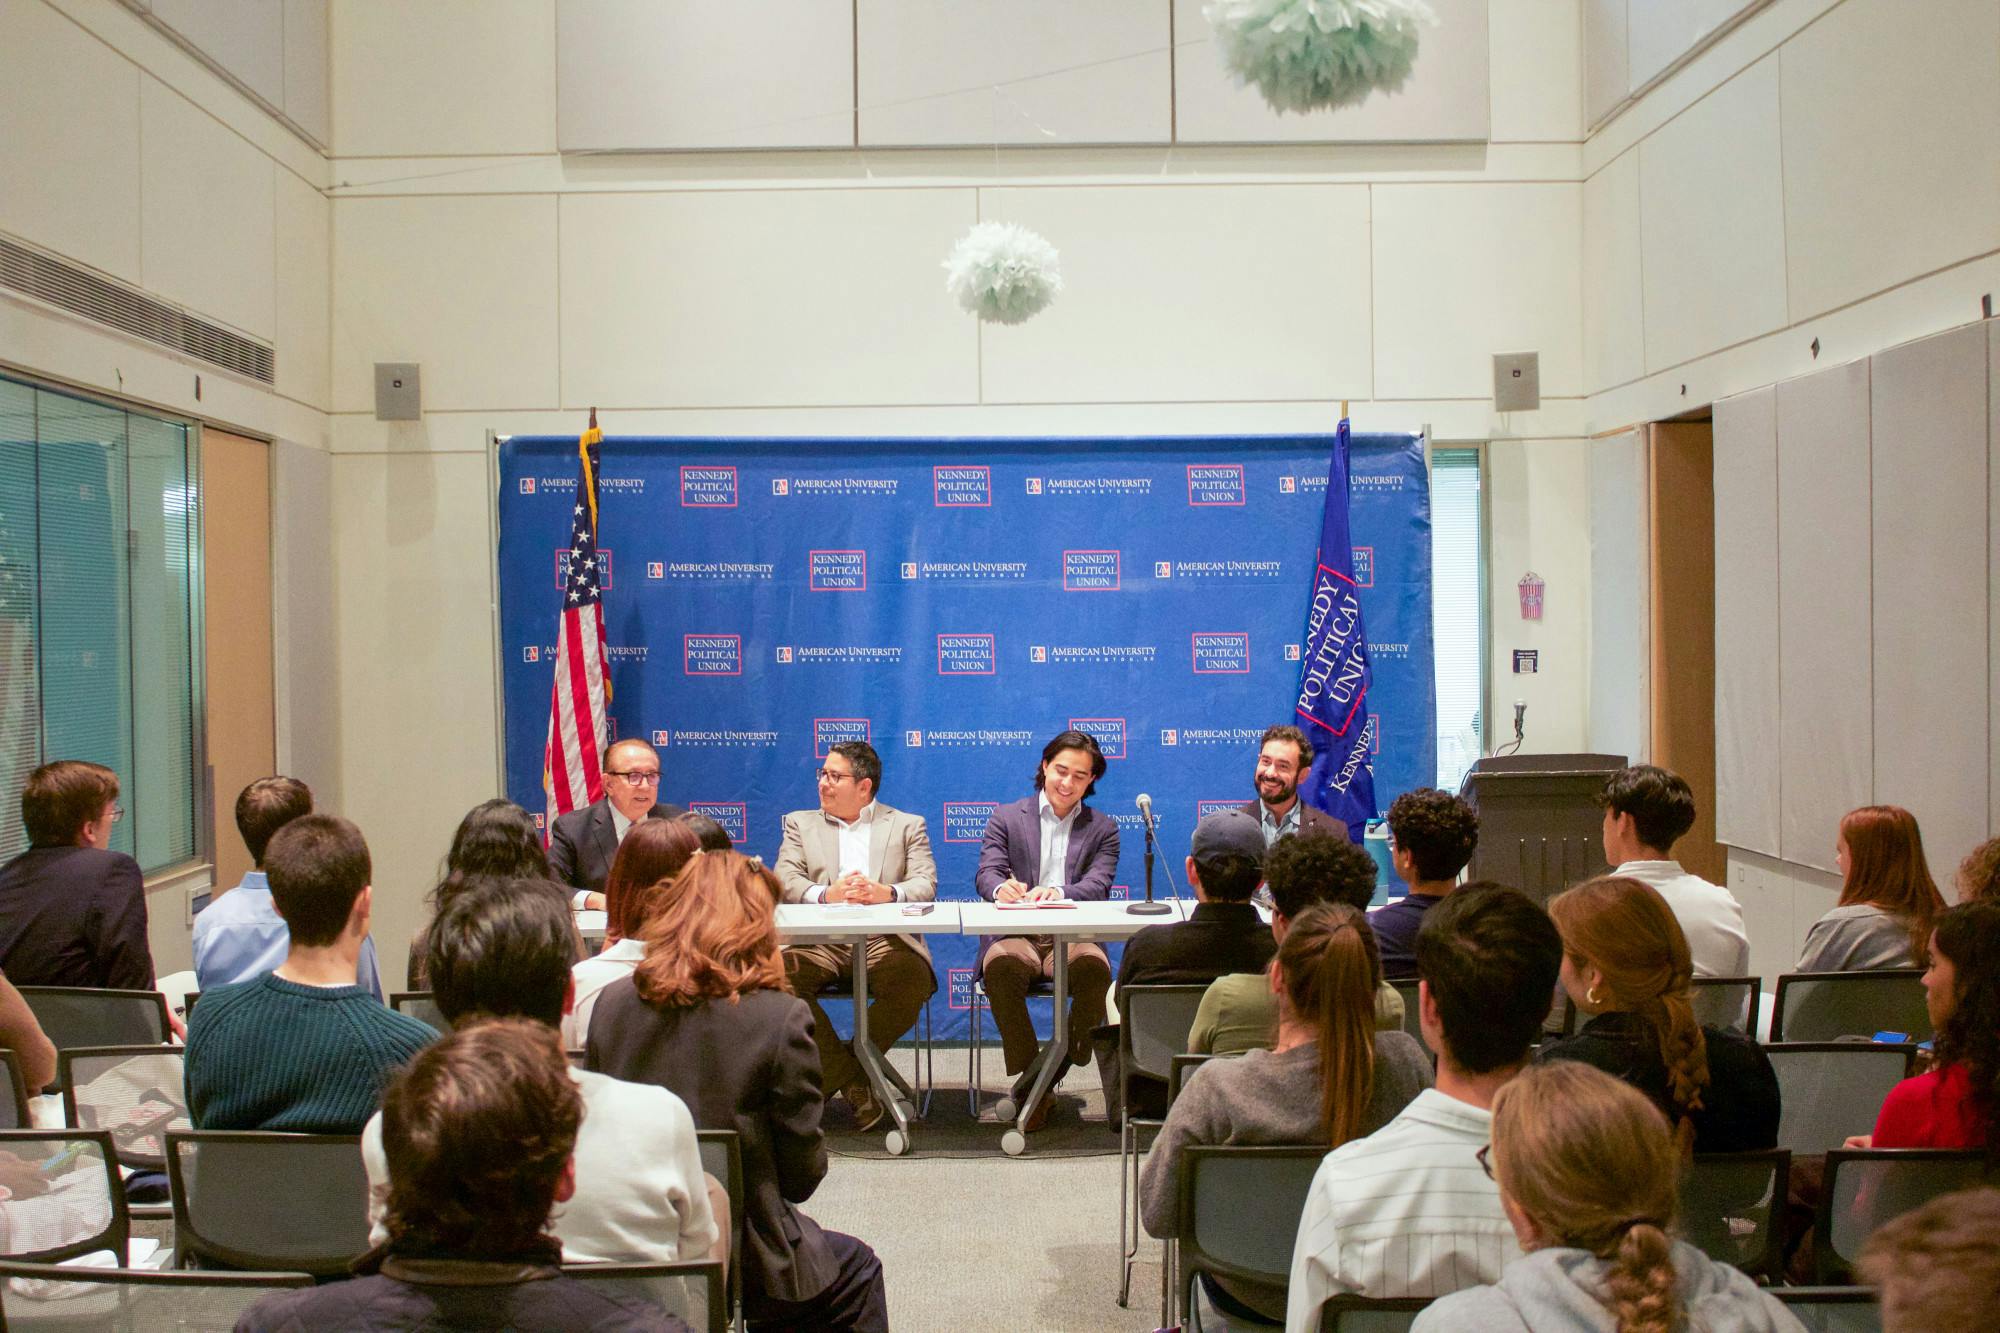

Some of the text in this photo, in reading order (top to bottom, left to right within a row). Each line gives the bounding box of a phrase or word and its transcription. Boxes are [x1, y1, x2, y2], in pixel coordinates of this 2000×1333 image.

[938, 471, 985, 479] KENNEDY
[1191, 470, 1239, 478] KENNEDY
[600, 479, 644, 487] NIVERSITY
[844, 479, 898, 488] UNIVERSITY
[1048, 480, 1095, 488] AMERICAN
[1098, 479, 1151, 487] UNIVERSITY
[1301, 477, 1328, 485] AMERI
[1351, 476, 1403, 484] UNIVERSITY
[685, 483, 734, 491] POLITICAL
[938, 482, 987, 490] POLITICAL
[1191, 481, 1242, 489] POLITICAL
[695, 494, 727, 502] UNION
[948, 493, 980, 502] UNION
[814, 555, 863, 563] KENNEDY
[1068, 555, 1115, 563] KENNEDY
[720, 563, 773, 572] UNIVERSITY
[922, 563, 970, 571] AMERICAN
[973, 563, 1026, 571] UNIVERSITY
[1177, 562, 1224, 570] AMERICAN
[1227, 561, 1280, 570] UNIVERSITY
[813, 567, 862, 575] POLITICAL
[1066, 566, 1118, 574] POLITICAL
[824, 578, 855, 586] UNION
[942, 639, 990, 647] KENNEDY
[1196, 638, 1244, 646] KENNEDY
[688, 650, 738, 659] POLITICAL
[849, 647, 901, 655] UNIVERSITY
[941, 650, 992, 658] POLITICAL
[1103, 647, 1155, 655] UNIVERSITY
[1195, 649, 1246, 657] POLITICAL
[698, 662, 730, 670] UNION
[1206, 660, 1238, 668] UNION
[819, 723, 866, 731] KENNEDY
[1073, 723, 1122, 731] KENNEDY
[725, 731, 778, 740] UNIVERSITY
[979, 731, 1032, 740] UNIVERSITY
[1183, 729, 1266, 738] AMERICAN UNIVE
[692, 808, 742, 816] KENNEDY
[948, 807, 996, 815] KENNEDY
[947, 818, 989, 827] POLITIC
[958, 829, 985, 837] UNIO
